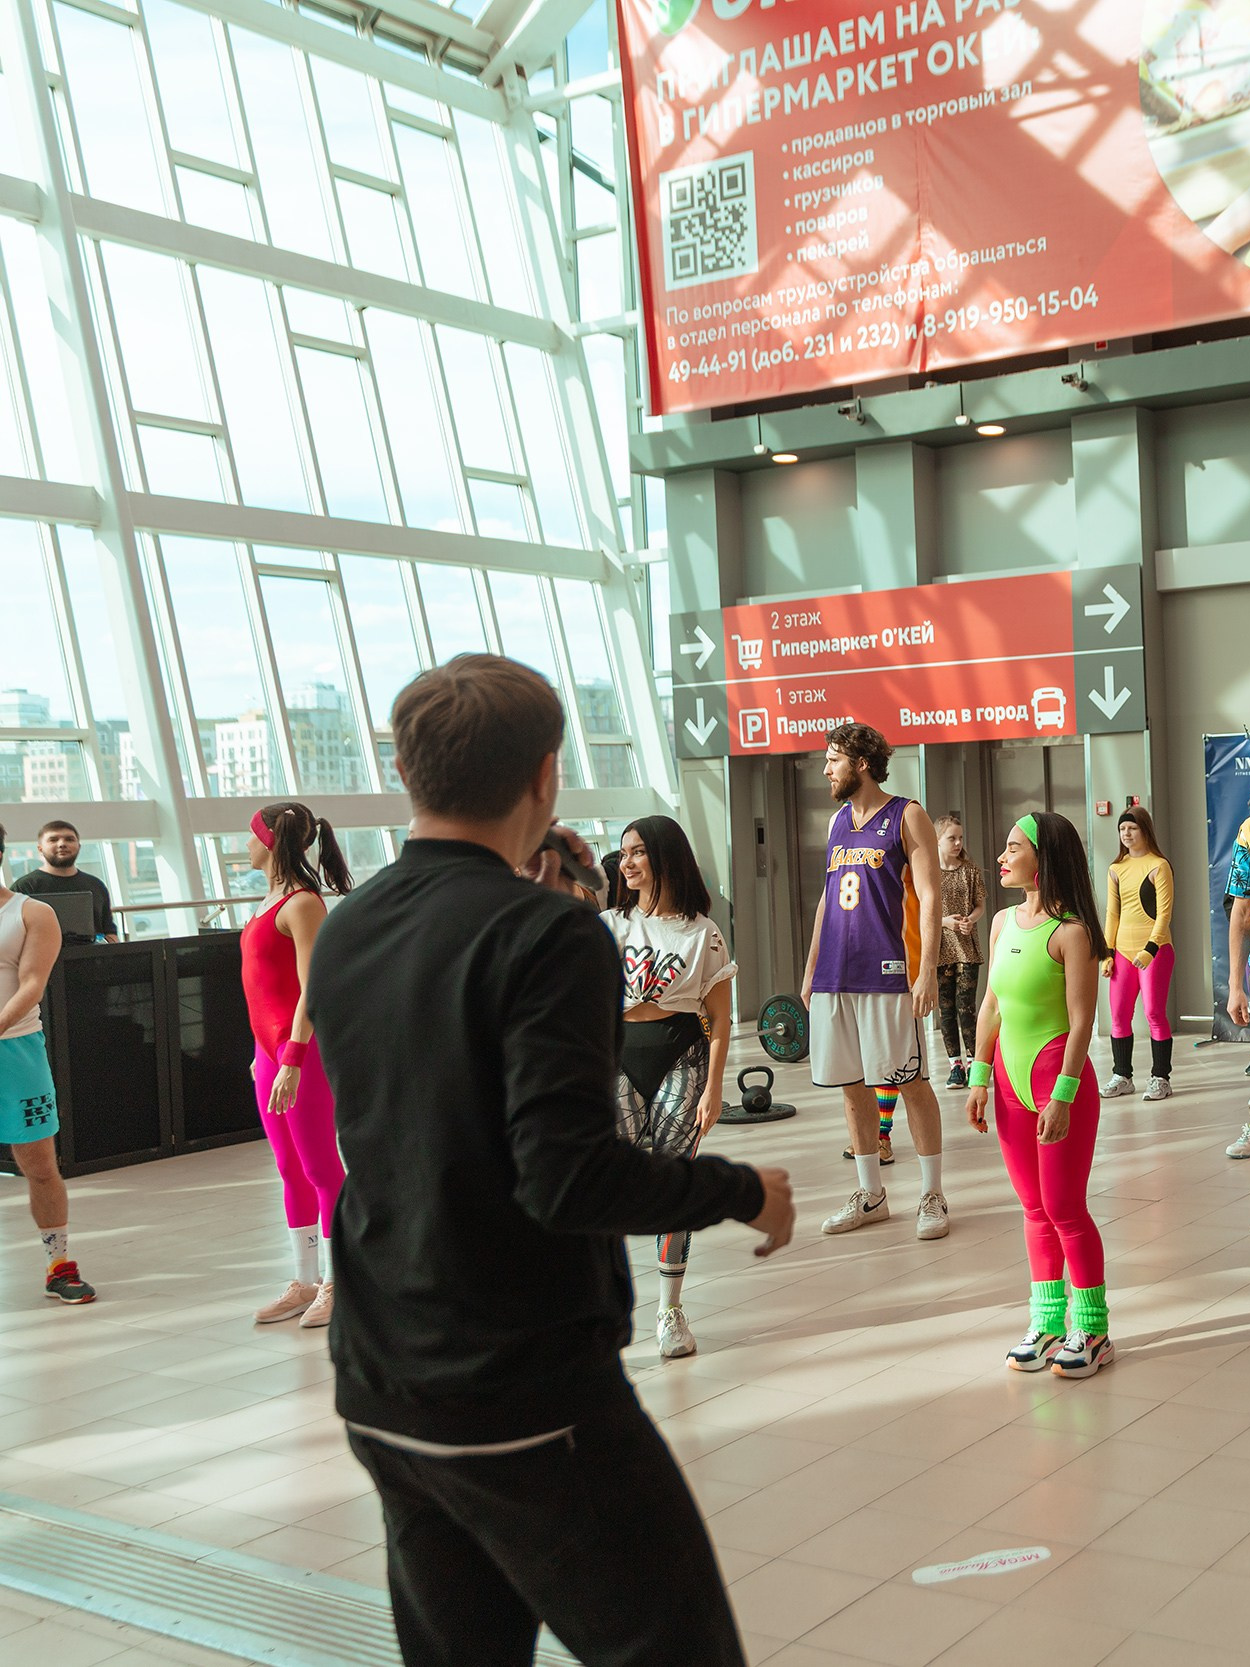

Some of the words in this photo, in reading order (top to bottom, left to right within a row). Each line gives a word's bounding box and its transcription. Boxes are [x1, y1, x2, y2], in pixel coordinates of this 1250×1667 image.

[895, 0, 946, 39] НА
[659, 114, 675, 147] В
[683, 48, 919, 141] ГИПЕРМАРКЕТ
[791, 114, 887, 156] продавцов
[891, 113, 902, 129] в
[905, 86, 996, 126] торговый
[1000, 80, 1032, 102] зал
[792, 149, 875, 182] кассиров
[794, 175, 884, 211] грузчиков
[795, 206, 868, 236] поваров
[796, 230, 870, 263] пекарей
[666, 306, 689, 327] По
[693, 292, 773, 322] вопросам
[777, 258, 930, 306] трудоустройства
[934, 236, 1047, 272] обращаться
[667, 336, 676, 350] в
[680, 325, 727, 347] отдел
[731, 307, 821, 340] персонала
[825, 303, 848, 319] по
[852, 279, 959, 314] телефонам:
[668, 347, 746, 383] 49-44-91
[751, 341, 800, 372] (доб.
[803, 332, 835, 360] 231
[840, 335, 853, 352] и
[856, 321, 900, 350] 232)
[904, 324, 917, 342] и
[923, 283, 1099, 338] 8-919-950-15-04
[771, 611, 780, 630] 2
[784, 611, 822, 629] этаж
[772, 634, 878, 658] Гипермаркет
[881, 620, 935, 648] О'КЕЙ
[776, 688, 782, 705] 1
[788, 688, 827, 705] этаж
[899, 707, 958, 727] Выход
[961, 708, 972, 723] в
[976, 704, 1029, 725] город
[827, 845, 885, 872] LAKERS
[839, 871, 860, 910] 8
[762, 1020, 785, 1055] STECTR
